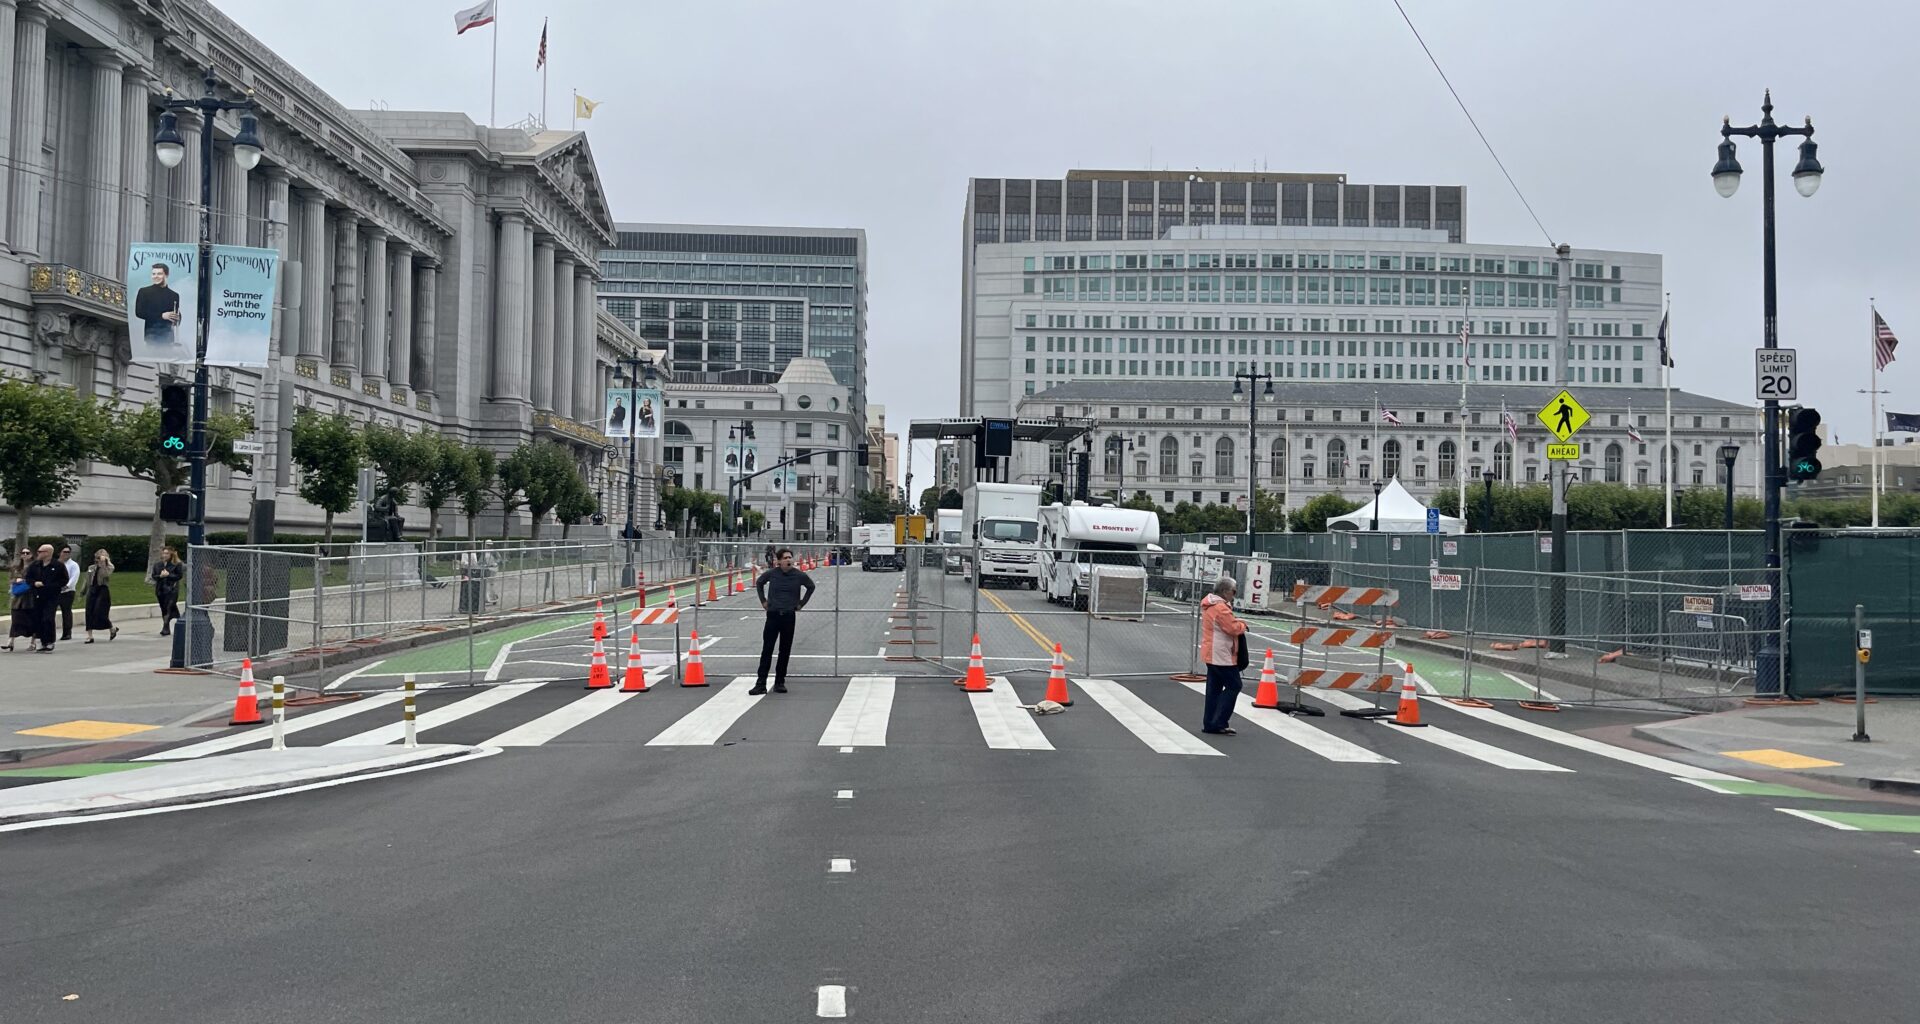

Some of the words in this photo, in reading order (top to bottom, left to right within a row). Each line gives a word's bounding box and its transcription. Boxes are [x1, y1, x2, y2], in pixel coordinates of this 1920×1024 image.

[223, 289, 263, 300] Summer
[224, 300, 243, 308] with
[245, 301, 260, 309] the
[217, 308, 266, 320] Symphony
[1760, 354, 1792, 363] SPEED
[1763, 365, 1789, 373] LIMIT
[1761, 375, 1792, 394] 20
[1551, 447, 1576, 456] AHEAD
[1432, 574, 1460, 582] NATIONAL
[1252, 565, 1263, 604] ICE
[1741, 585, 1770, 593] NATIONAL
[1684, 597, 1713, 606] NATIONAL
